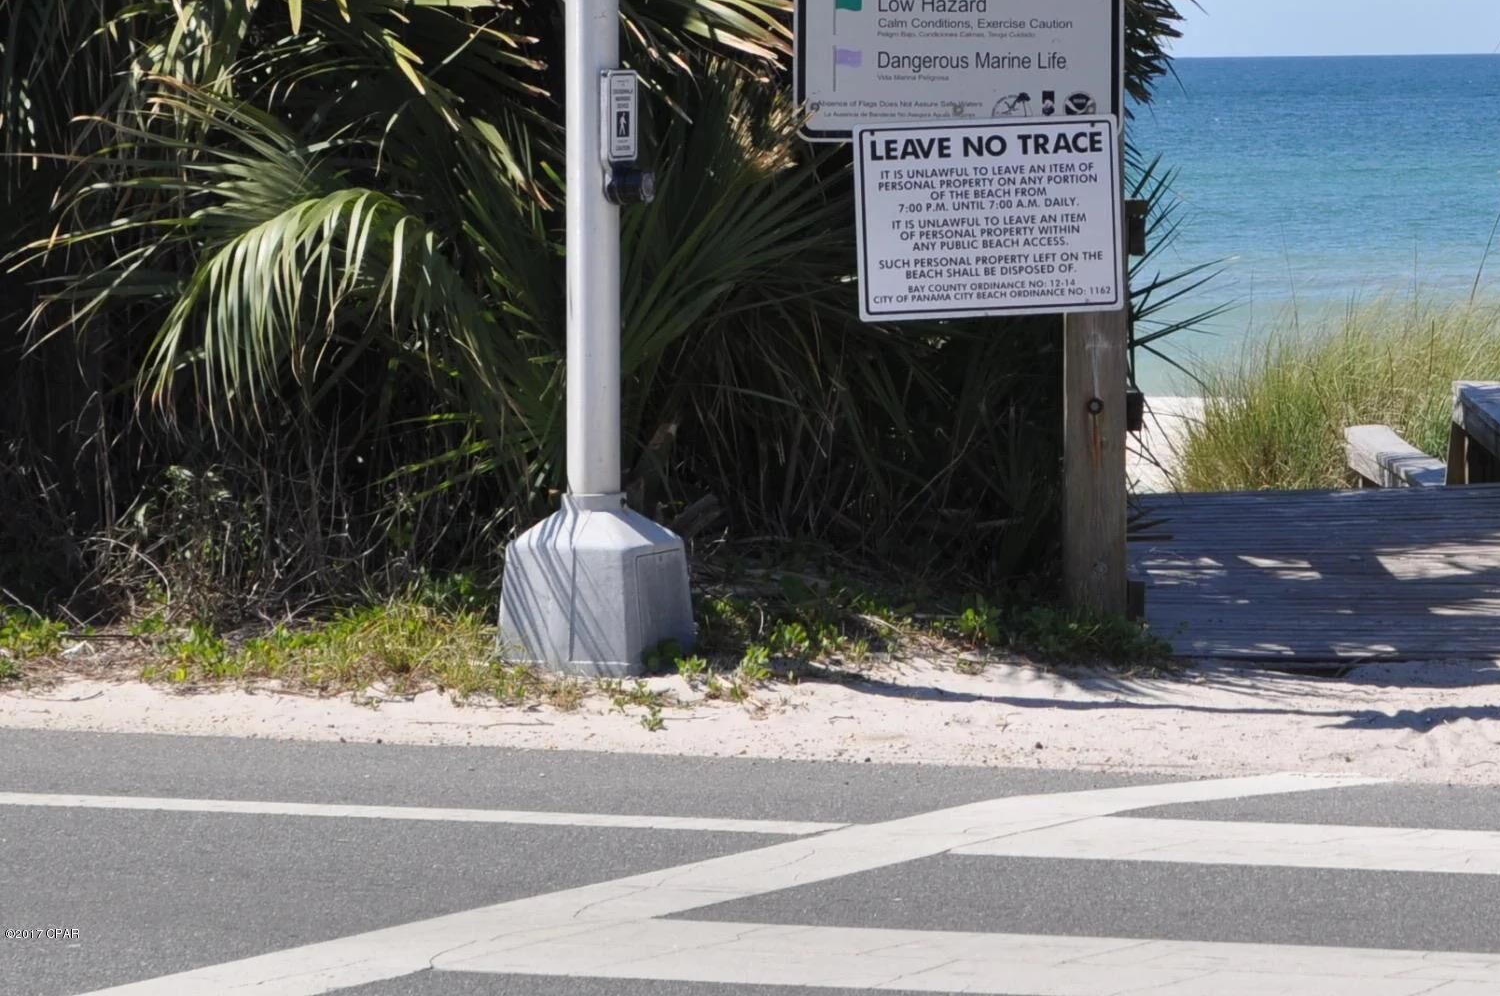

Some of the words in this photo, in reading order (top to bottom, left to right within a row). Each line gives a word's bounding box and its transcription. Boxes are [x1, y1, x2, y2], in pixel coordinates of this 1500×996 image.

[878, 18, 907, 29] Calm
[911, 18, 973, 31] Conditions,
[977, 18, 1025, 29] Exercise
[1029, 18, 1072, 29] Caution
[877, 51, 970, 73] Dangerous
[974, 52, 1032, 69] Marine
[1037, 52, 1068, 70] Life
[870, 137, 951, 161] LEAVE
[963, 135, 1006, 158] NO
[1017, 132, 1103, 153] TRACE
[880, 170, 891, 180] IT
[893, 169, 904, 179] IS
[906, 167, 970, 179] UNLAWFUL
[972, 166, 989, 177] TO
[991, 165, 1025, 176] LEAVE
[1028, 164, 1046, 175] AN
[1048, 163, 1076, 174] ITEM
[1078, 162, 1094, 173] OF
[878, 180, 935, 192] PERSONAL
[939, 178, 993, 189] PROPERTY
[997, 177, 1016, 187] ON
[1020, 176, 1042, 186] ANY
[1047, 174, 1097, 185] PORTION
[929, 191, 946, 201] OF
[948, 190, 970, 200] THE
[973, 188, 1011, 199] BEACH
[1014, 187, 1047, 198] FROM
[898, 203, 923, 213] 7:00
[925, 202, 949, 212] P.M.
[951, 201, 986, 211] UNTIL
[988, 200, 1013, 210] 7:00
[1015, 199, 1040, 209] A.M.
[1043, 198, 1080, 208] DAILY.
[891, 220, 902, 230] IT
[904, 219, 915, 229] IS
[917, 217, 981, 229] UNLAWFUL
[983, 216, 1000, 226] TO
[1002, 214, 1037, 225] LEAVE
[1039, 214, 1057, 224] AN
[1060, 213, 1087, 223] ITEM
[900, 231, 915, 241] OF
[919, 228, 976, 240] PERSONAL
[980, 226, 1034, 238] PROPERTY
[1038, 225, 1080, 235] WITHIN
[912, 242, 936, 252] ANY
[939, 240, 979, 251] PUBLIC
[981, 239, 1019, 249] BEACH
[1022, 237, 1069, 248] ACCESS.
[878, 258, 910, 270] SUCH
[913, 256, 972, 268] PERSONAL
[974, 254, 1030, 266] PROPERTY
[1032, 253, 1057, 264] LEFT
[1059, 252, 1079, 263] ON
[1081, 251, 1103, 262] THE
[905, 269, 943, 280] BEACH
[945, 267, 981, 278] SHALL
[983, 267, 997, 276] BE
[999, 264, 1055, 276] DISPOSED
[1057, 264, 1077, 274] OF.
[907, 285, 926, 294] BAY
[927, 283, 967, 293] COUNTY
[969, 281, 1026, 291] ORDINANCE
[1028, 281, 1047, 289] NO:
[1050, 280, 1076, 288] 12-14
[872, 296, 893, 305] CITY
[895, 295, 908, 304] OF
[910, 293, 952, 303] PANAMA
[953, 292, 974, 301] CITY
[975, 291, 1007, 300] BEACH
[1008, 289, 1065, 299] ORDINANCE
[1067, 288, 1086, 297] NO:
[1089, 287, 1111, 296] 1162
